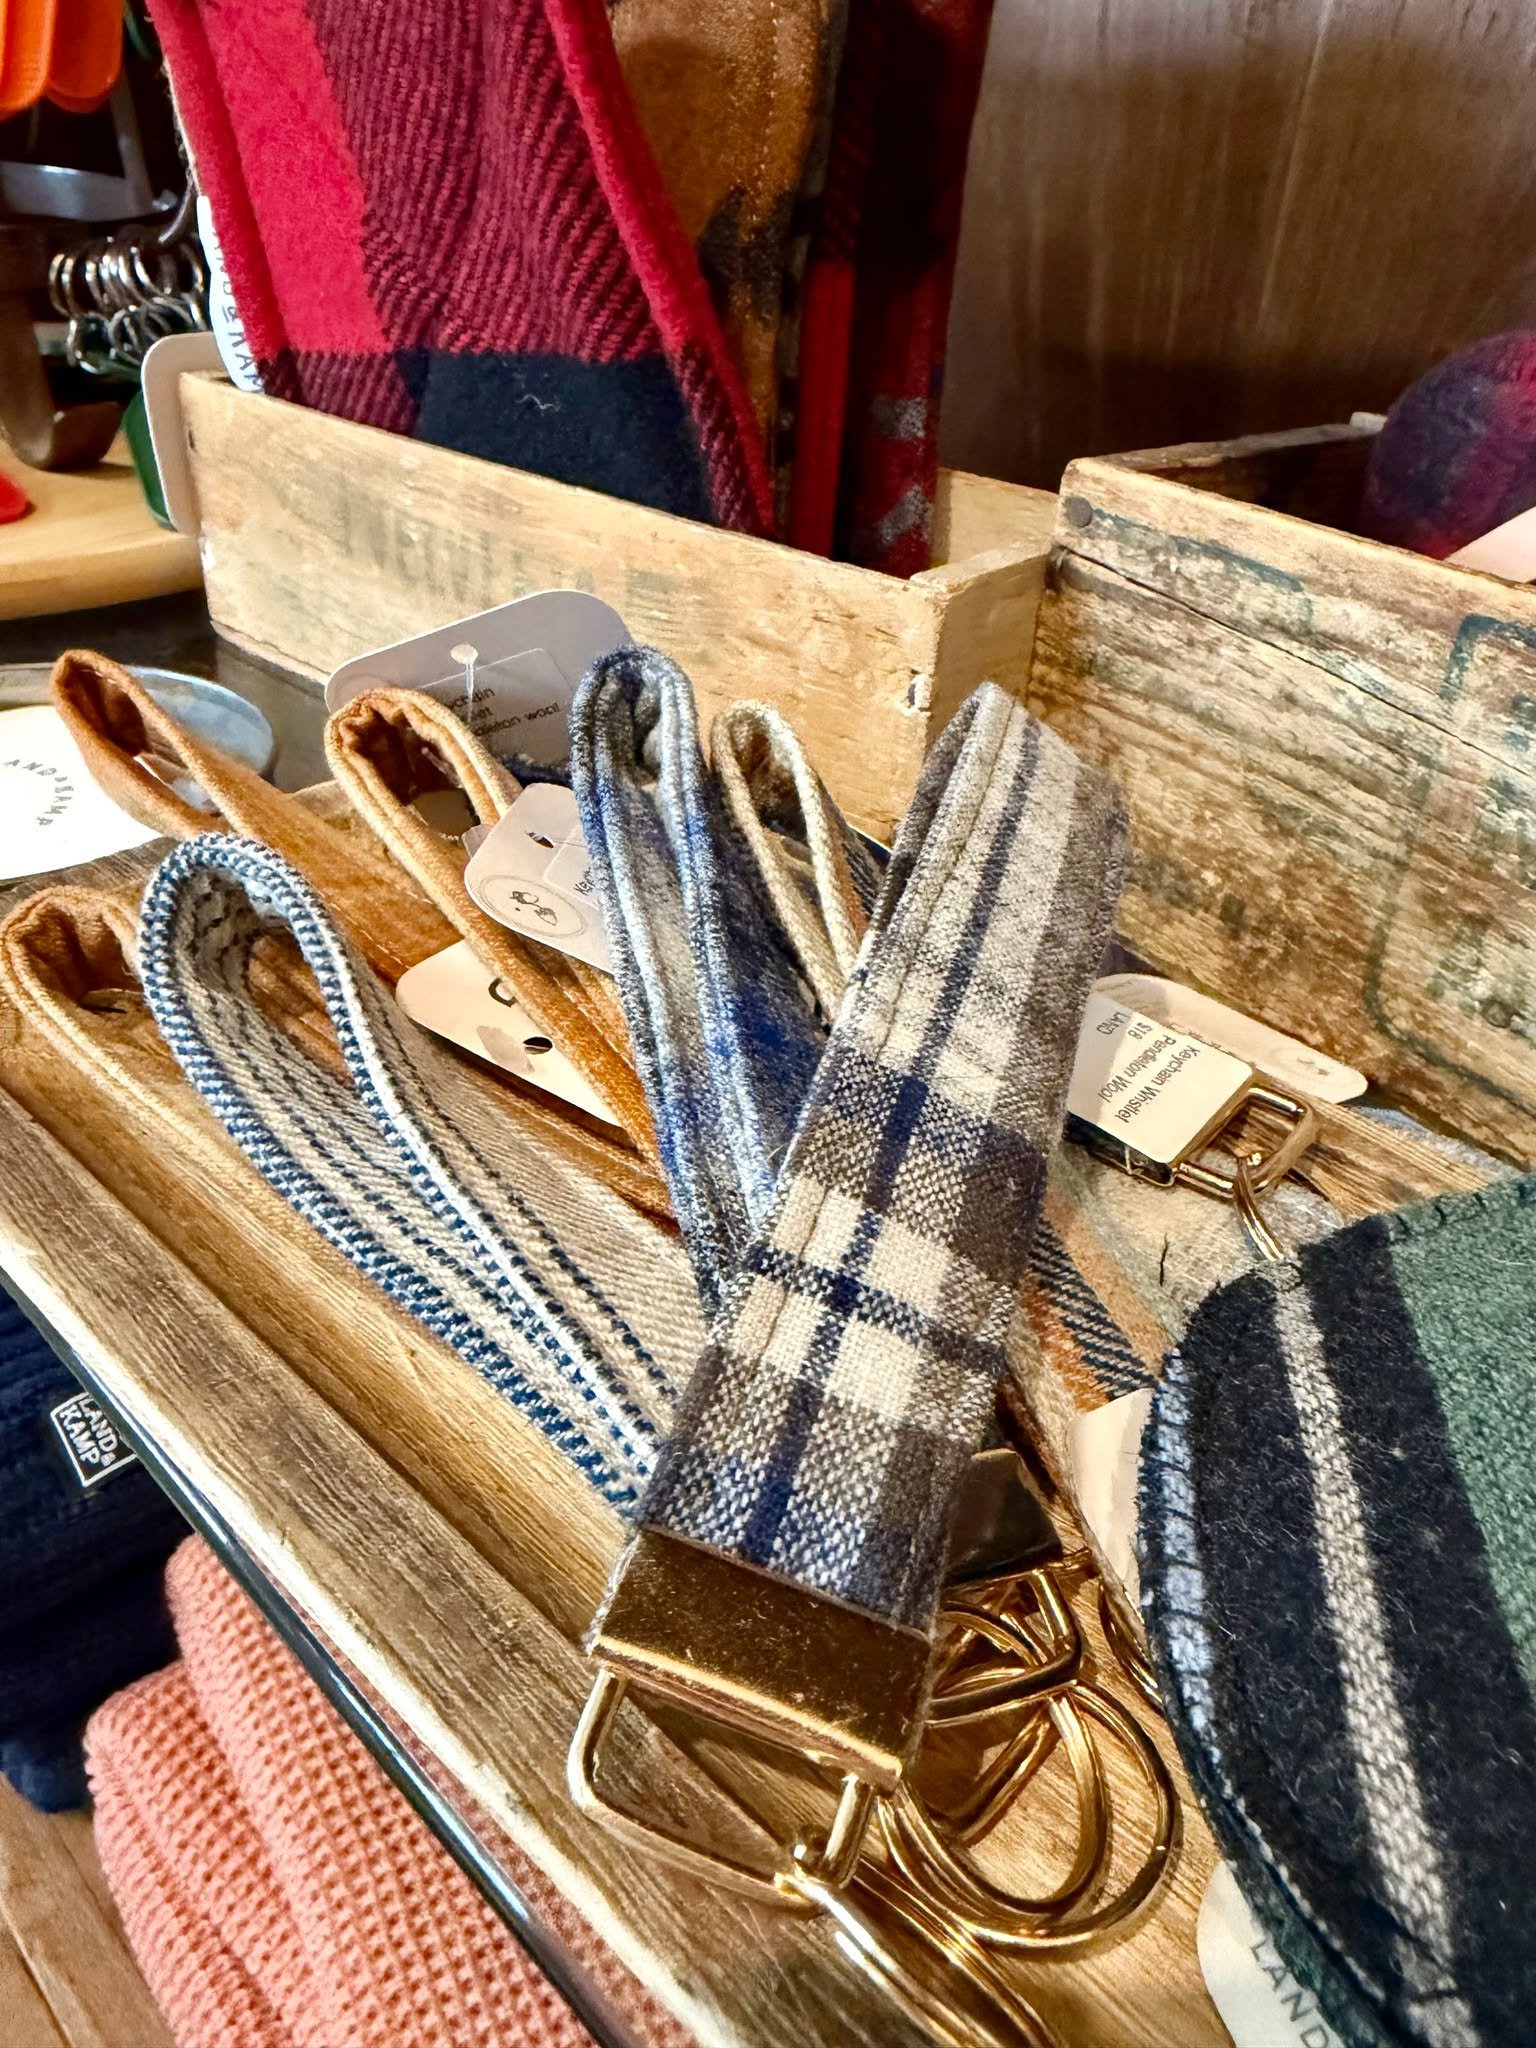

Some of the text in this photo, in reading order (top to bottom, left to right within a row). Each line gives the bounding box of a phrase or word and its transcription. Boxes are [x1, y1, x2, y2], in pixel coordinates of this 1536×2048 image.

[524, 702, 561, 721] wool
[1126, 1034, 1176, 1077] Pendleton
[1151, 1045, 1201, 1087] Keychain
[1098, 1071, 1132, 1103] Wool
[60, 1404, 100, 1463] KAMP
[79, 1399, 118, 1452] LAND
[1250, 1937, 1329, 2048] LAND
